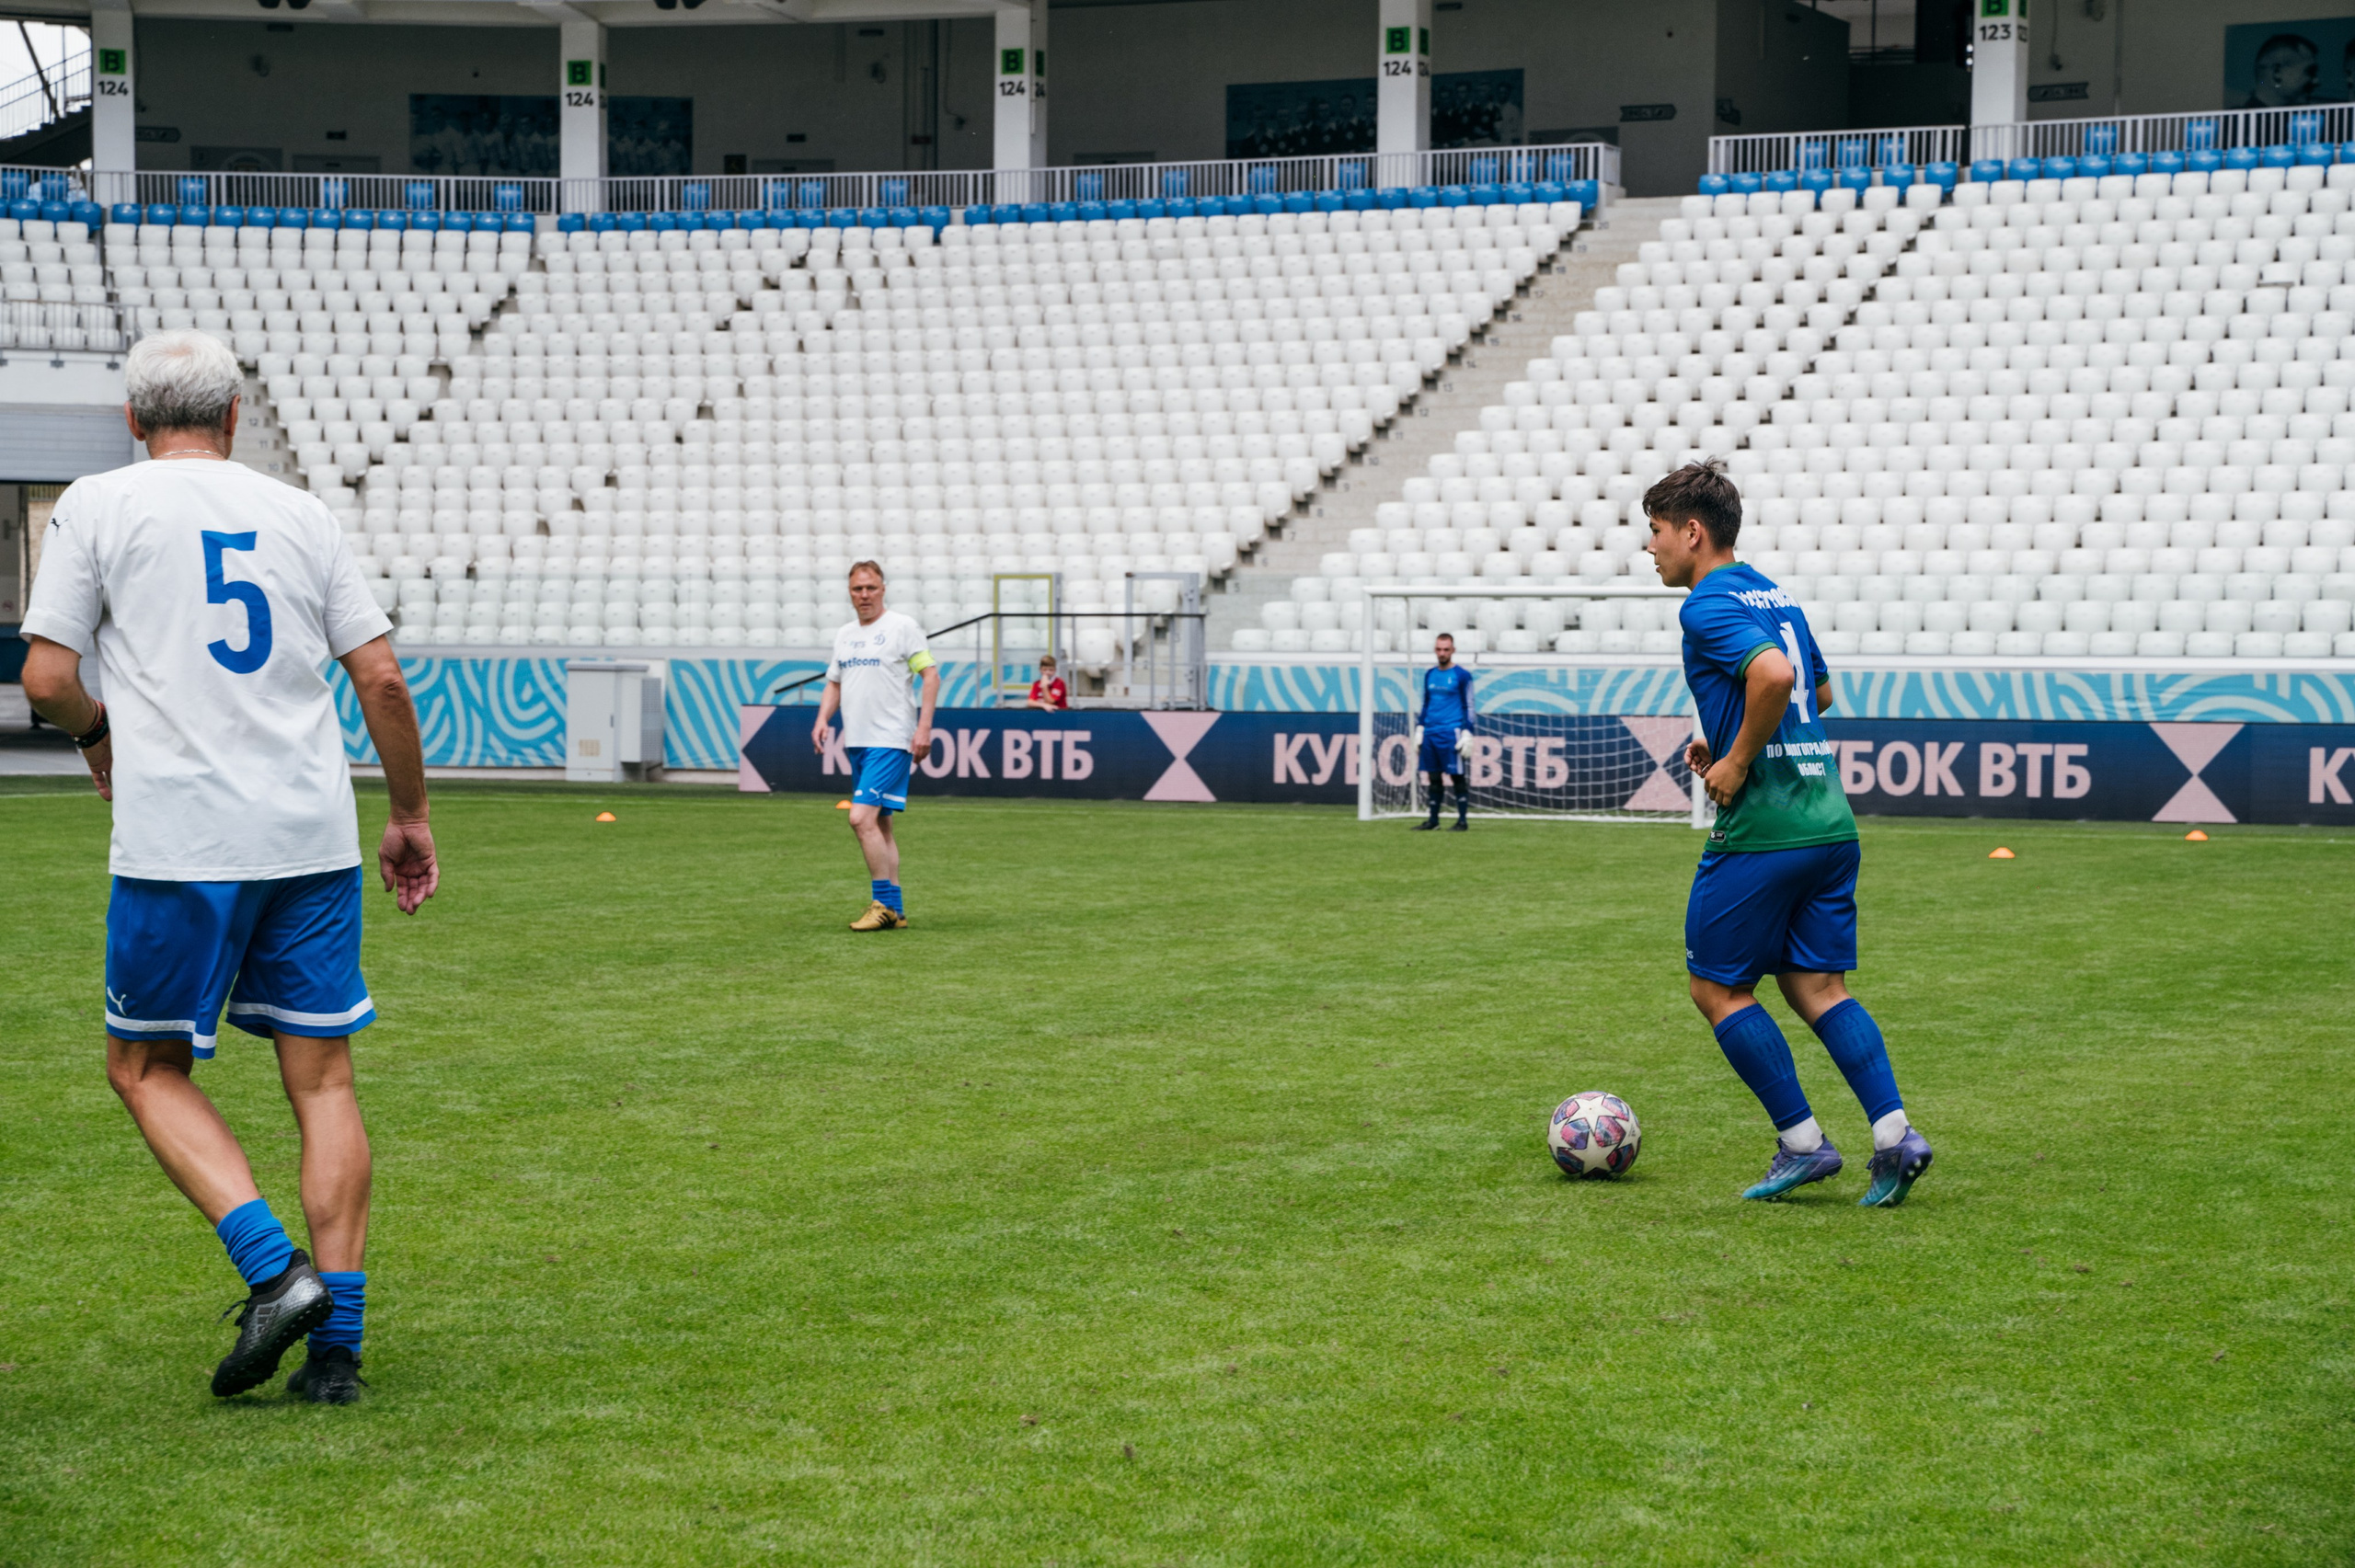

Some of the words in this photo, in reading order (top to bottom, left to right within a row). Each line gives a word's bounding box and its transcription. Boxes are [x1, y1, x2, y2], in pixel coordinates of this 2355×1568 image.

[1979, 24, 2012, 41] 123
[1383, 61, 1412, 76] 124
[98, 80, 129, 96] 124
[999, 81, 1026, 96] 124
[566, 92, 594, 107] 124
[201, 530, 273, 675] 5
[822, 727, 992, 779] КОК
[1003, 729, 1094, 781] ВТБ
[1766, 743, 1784, 759] ПО
[1273, 733, 1453, 786] КУБО
[1470, 736, 1569, 789] ВТБ
[1825, 739, 1966, 797] БОК
[1979, 742, 2092, 799] ВТБ
